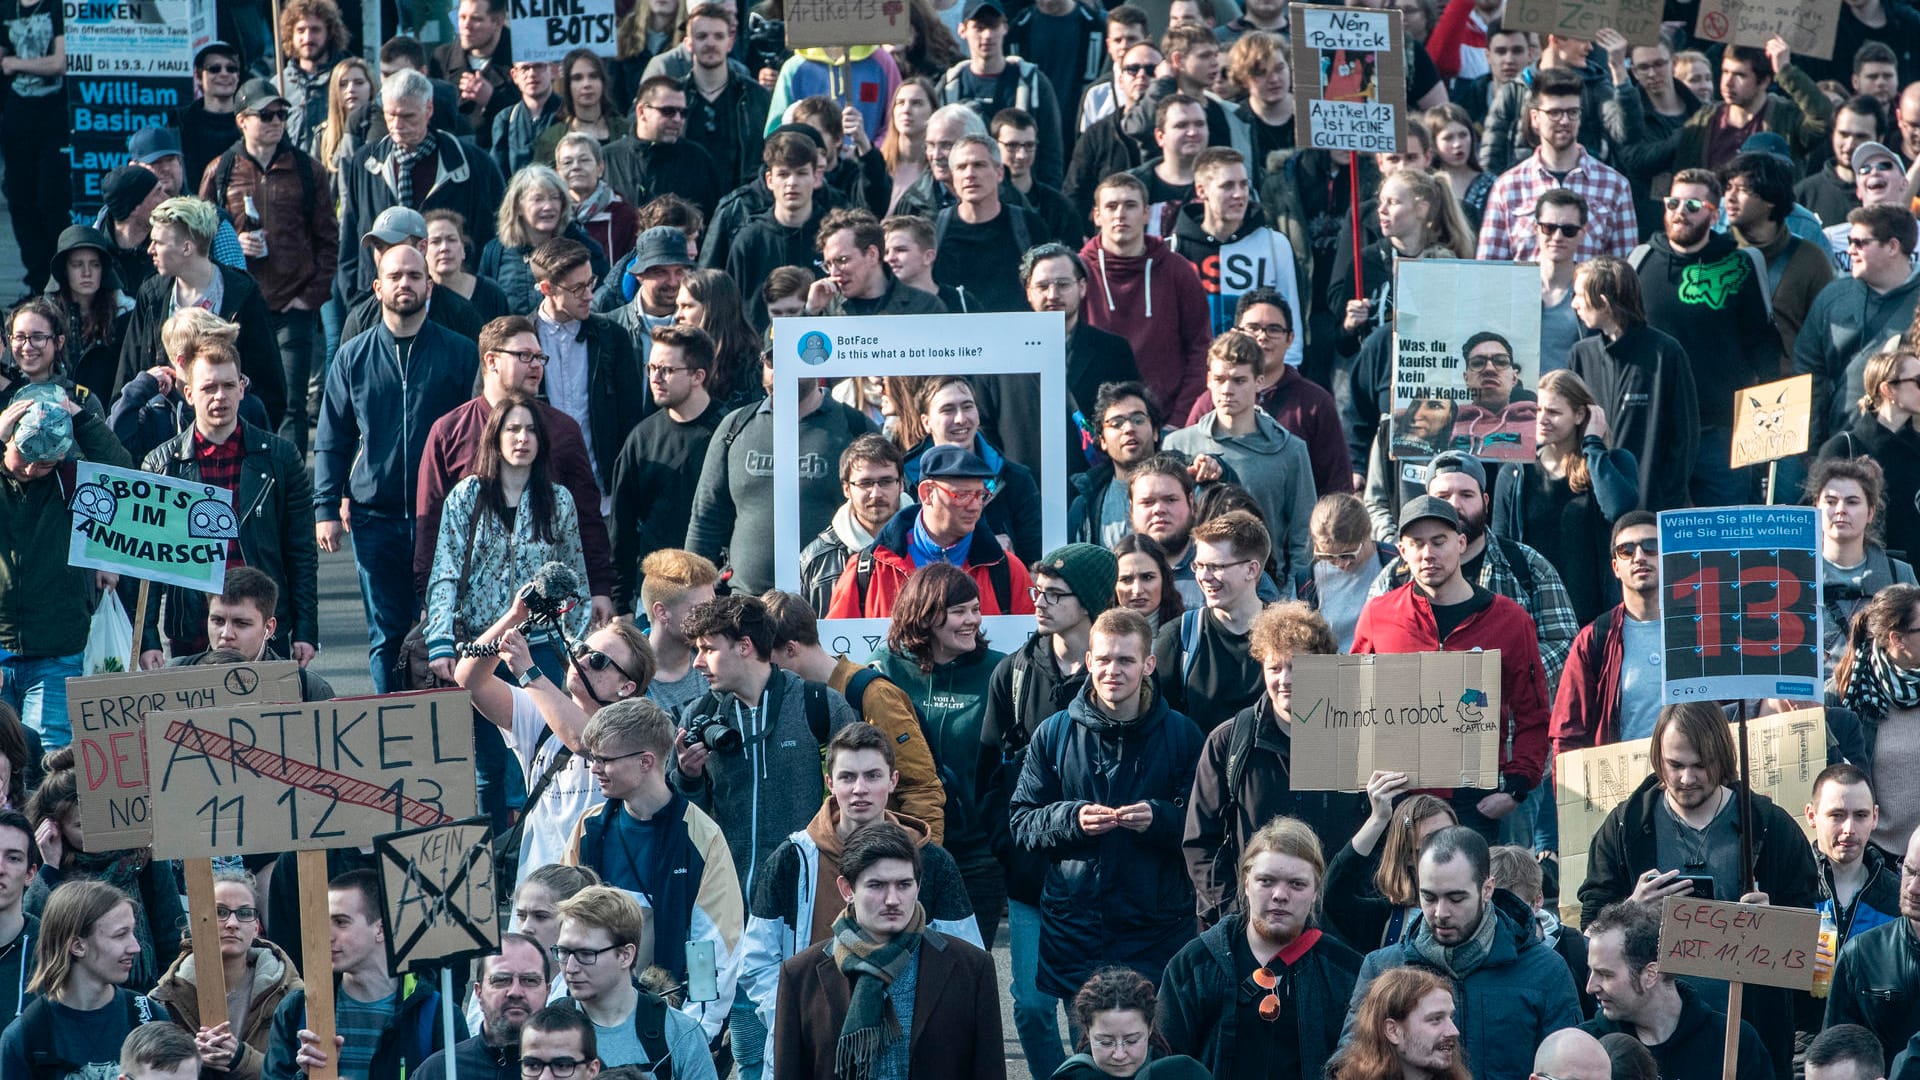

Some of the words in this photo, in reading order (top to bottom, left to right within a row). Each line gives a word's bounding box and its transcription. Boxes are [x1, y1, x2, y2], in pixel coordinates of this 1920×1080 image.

[64, 3, 143, 20] DENKEN
[511, 0, 585, 19] KEINE
[139, 26, 164, 34] Think
[167, 26, 188, 35] Tank
[546, 13, 614, 46] BOTS!
[1329, 12, 1370, 31] Nein
[1310, 30, 1385, 48] Patrick
[66, 54, 93, 72] HAU
[97, 59, 110, 70] Di
[114, 59, 146, 71] 19.3.
[157, 60, 190, 71] HAU1
[79, 81, 178, 106] William
[74, 108, 169, 132] Basins
[1311, 102, 1369, 119] Artikel
[1371, 106, 1391, 121] 13
[1323, 118, 1345, 131] ist
[1351, 120, 1385, 134] KEINE
[1314, 132, 1357, 148] GUTE
[1359, 134, 1395, 151] IDEE
[69, 146, 132, 170] Lawr
[837, 335, 879, 346] BotFace
[1399, 339, 1428, 353] Was,
[1430, 340, 1447, 352] du
[837, 350, 846, 360] Is
[849, 349, 868, 359] this
[871, 348, 897, 358] what
[899, 350, 906, 358] a
[909, 348, 926, 358] bot
[928, 347, 956, 357] looks
[958, 347, 983, 357] like?
[1398, 355, 1437, 368] kaufst
[1441, 356, 1459, 369] dir
[1398, 370, 1426, 383] kein
[111, 480, 193, 510] BOTS
[132, 503, 167, 528] IM
[1664, 515, 1713, 528] Wählen
[1716, 514, 1737, 525] Sie
[1740, 513, 1763, 525] alle
[1766, 514, 1812, 525] Artikel,
[75, 518, 226, 565] ANMARSCH
[1673, 529, 1693, 540] die
[1697, 528, 1717, 538] Sie
[1721, 527, 1754, 538] nicht
[1757, 526, 1803, 536] wollen!
[1672, 566, 1806, 657] 13
[80, 692, 166, 732] ERROR
[176, 687, 216, 708] 404
[1324, 697, 1348, 729] I'm
[1353, 695, 1379, 728] not
[1384, 707, 1396, 726] a
[1400, 690, 1448, 727] robot
[1452, 721, 1498, 734] reCAPTCHA
[160, 701, 468, 792] ARTIKEL
[109, 794, 150, 829] NO
[196, 794, 245, 847] 11
[276, 783, 346, 840] 12
[378, 777, 444, 832] 13
[419, 827, 465, 866] KEIN
[1673, 903, 1766, 935] GEGEN
[1668, 939, 1711, 960] ART.
[1745, 943, 1776, 970] 12,
[1781, 948, 1807, 969] 13
